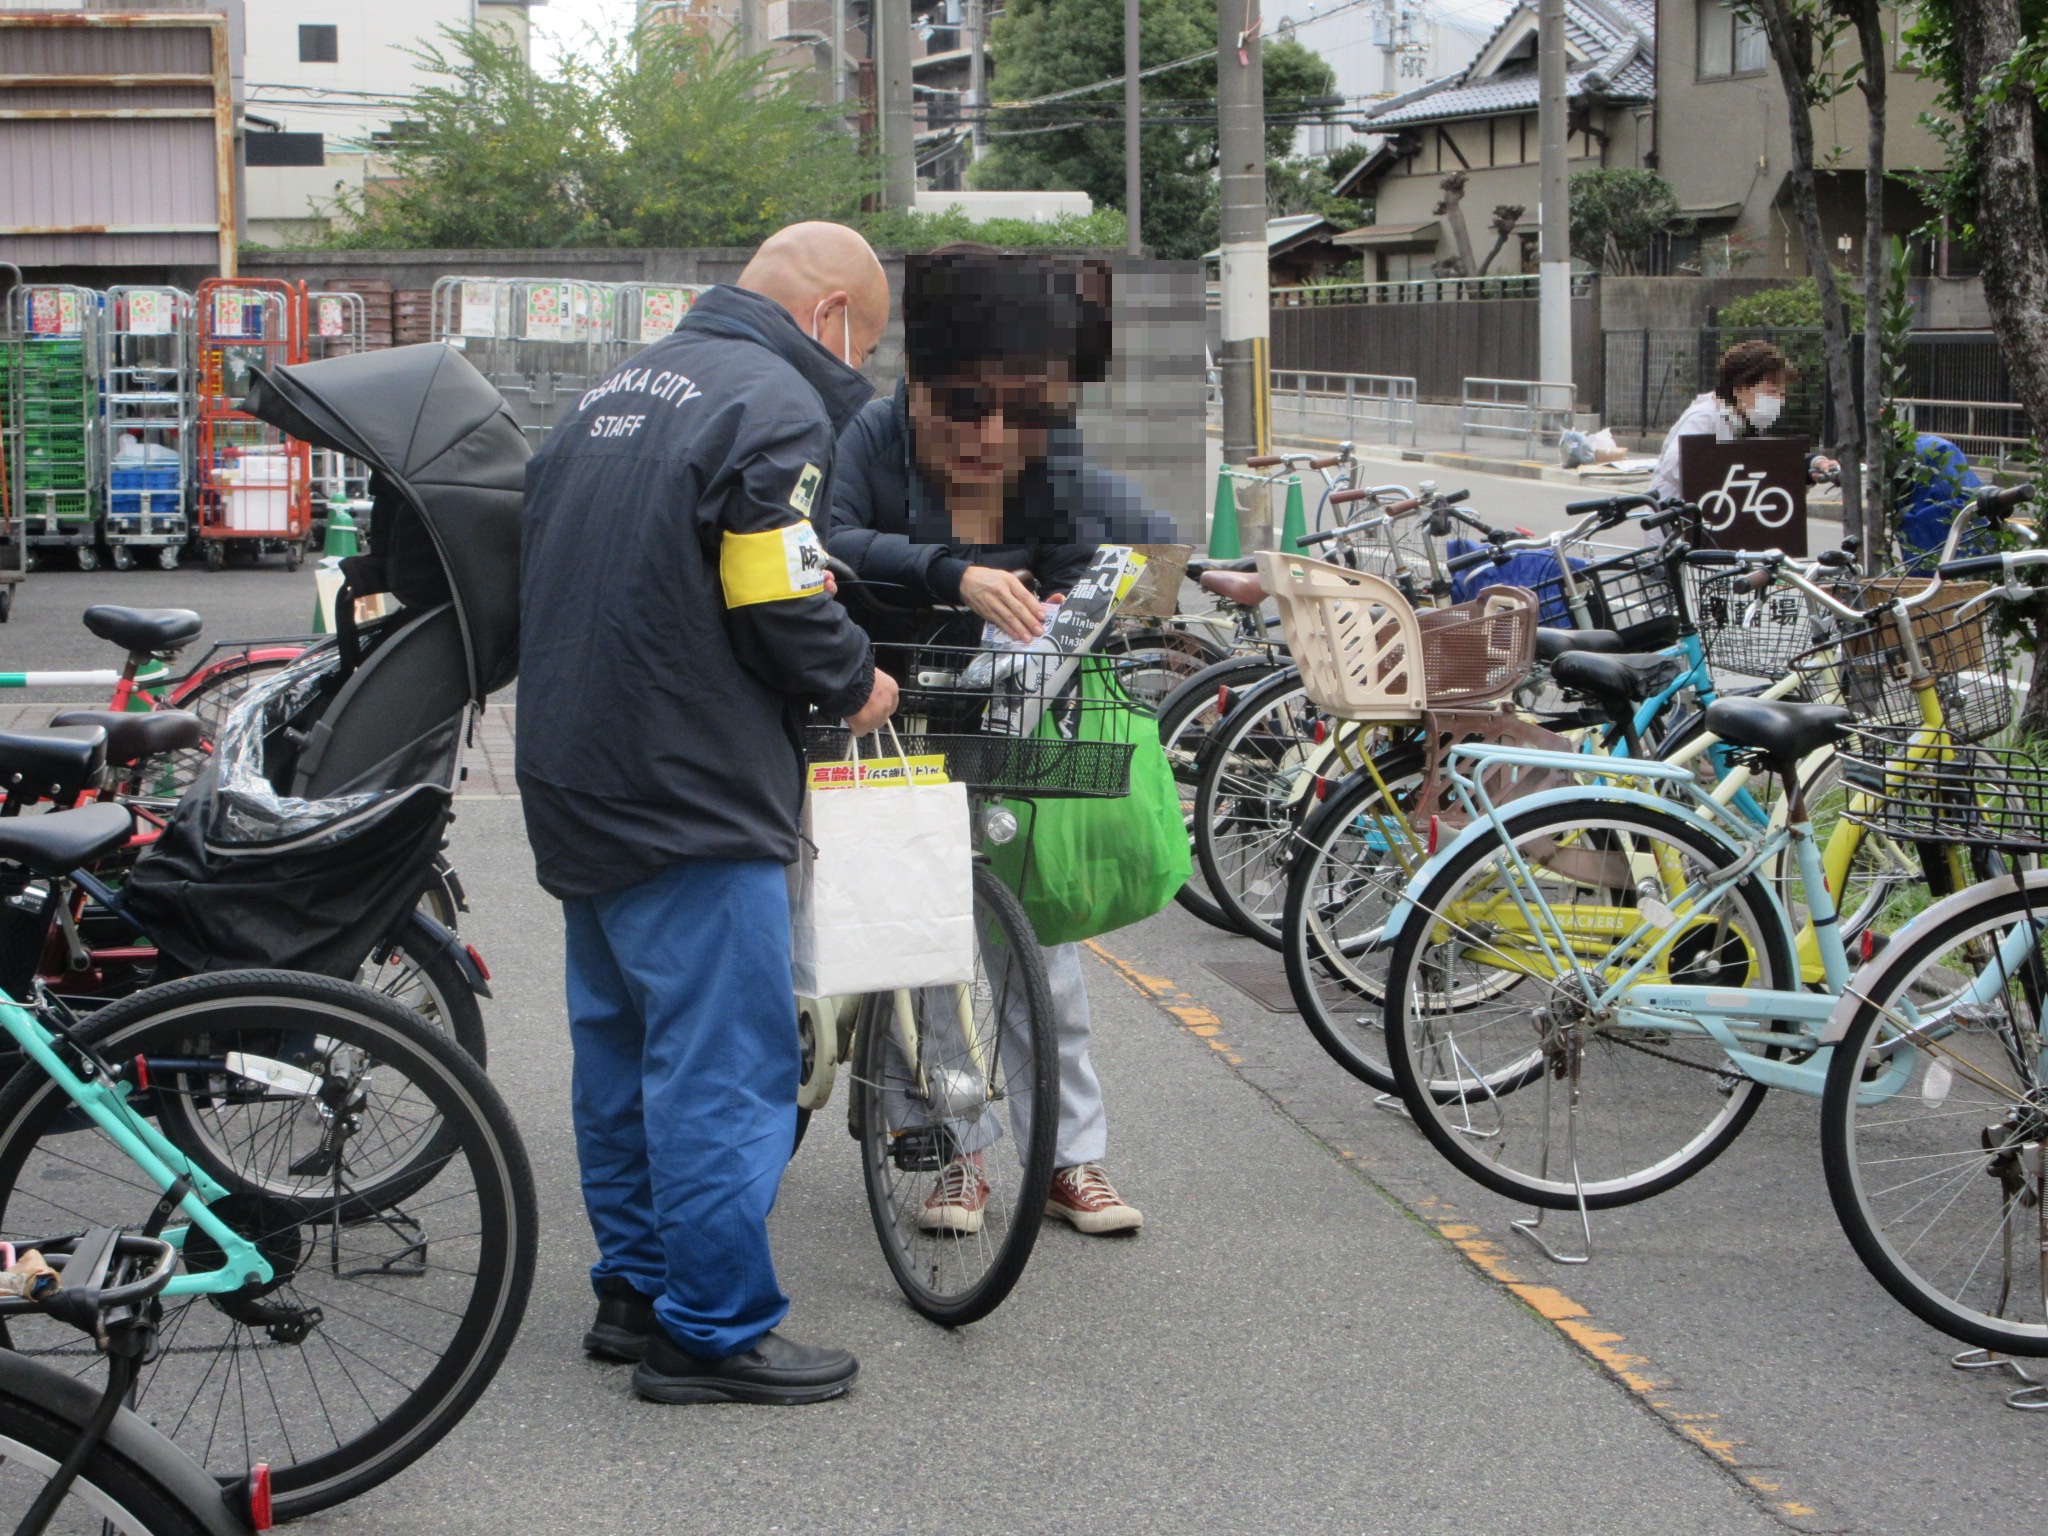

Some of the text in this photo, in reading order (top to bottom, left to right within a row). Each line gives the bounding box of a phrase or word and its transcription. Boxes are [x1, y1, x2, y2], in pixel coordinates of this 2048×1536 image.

[578, 368, 702, 411] OSAKA CITY
[590, 415, 646, 437] STAFF
